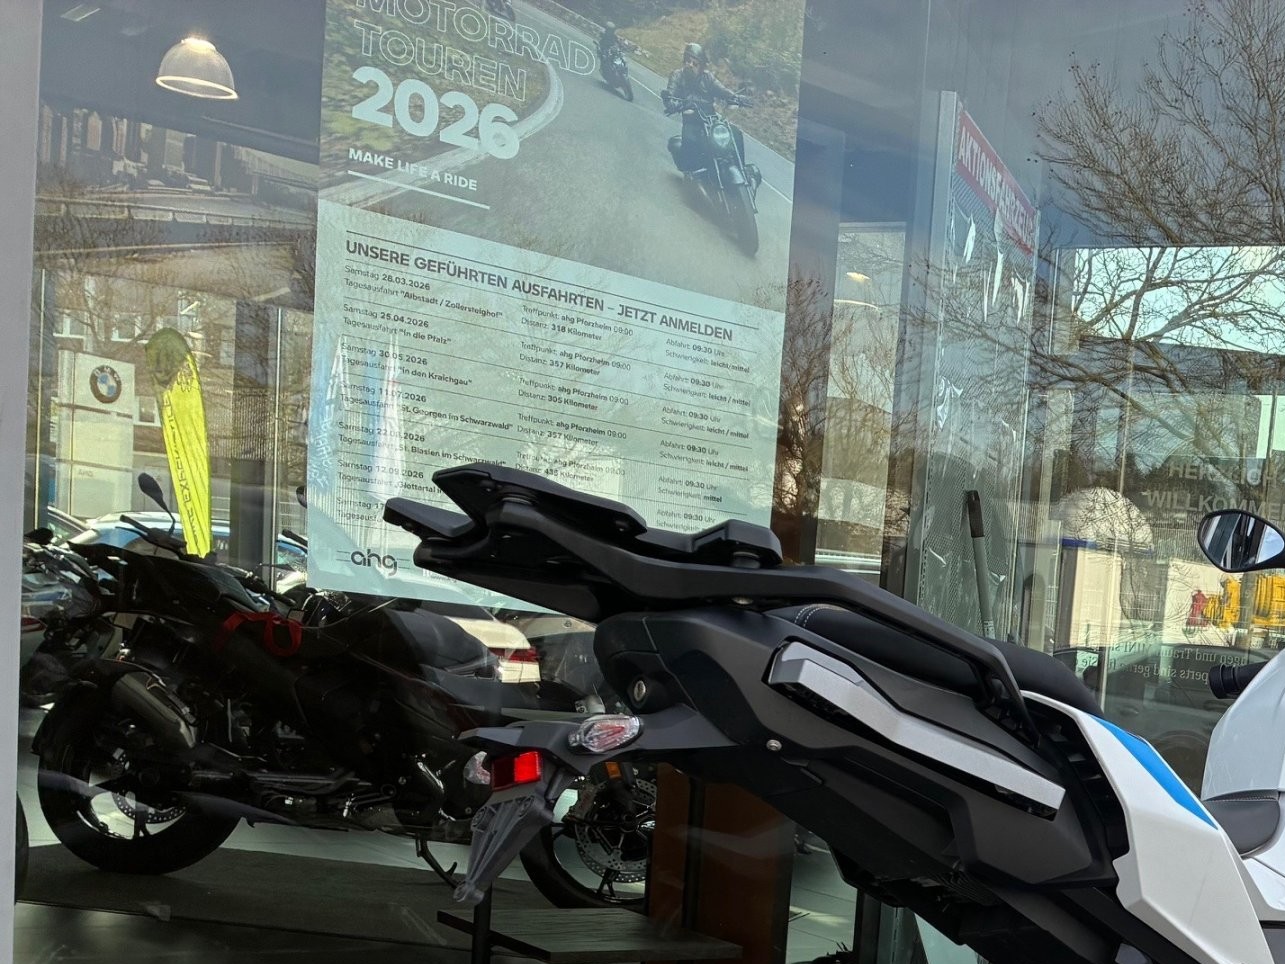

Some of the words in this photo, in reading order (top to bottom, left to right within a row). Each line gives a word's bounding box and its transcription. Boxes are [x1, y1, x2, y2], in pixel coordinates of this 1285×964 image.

[353, 19, 527, 101] TOUREN
[351, 66, 521, 160] 2026
[348, 147, 394, 171] MAKE
[397, 159, 428, 179] LIFE
[430, 168, 442, 182] A
[444, 172, 478, 191] RIDE
[344, 265, 379, 281] Samstag
[382, 273, 430, 291] 28.03.2026
[344, 278, 399, 297] Tagesausfahrt
[346, 240, 410, 267] UNSERE
[414, 256, 508, 289] GEFÜHRTEN
[511, 279, 604, 312] AUSFAHRTEN
[617, 304, 657, 323] JETZT
[659, 314, 733, 341] ANMELDEN
[343, 304, 378, 319] Samstag
[380, 312, 429, 328] 25.04.2026
[522, 305, 559, 320] Treffpunkt:
[561, 315, 575, 325] ahg
[576, 317, 612, 332] Pforzheim
[343, 317, 398, 335] Tagesausfahrt
[413, 331, 426, 341] die
[521, 317, 549, 329] Distanz:
[551, 323, 566, 333] 318
[567, 327, 602, 340] Kilometer
[341, 343, 376, 357] Samstag
[521, 342, 558, 357] Treffpunkt:
[559, 351, 573, 360] ahg
[574, 353, 610, 367] Pforzheim
[611, 360, 631, 372] 09:00
[666, 338, 691, 350] Abfahrt:
[692, 344, 712, 354] 09:30
[713, 349, 725, 357] Uhr
[411, 368, 426, 378] den
[519, 353, 548, 366] Distanz:
[549, 359, 564, 369] 357
[565, 362, 600, 376] Kilometer
[663, 372, 689, 384] Abfahrt:
[690, 378, 711, 388] 09:30
[518, 389, 545, 401] Distanz:
[547, 395, 562, 404] 305
[563, 398, 598, 411] Kilometer
[519, 377, 556, 391] Treffpunkt:
[558, 386, 571, 395] ahg
[572, 387, 608, 401] Pforzheim
[609, 395, 629, 405] 09:00
[708, 393, 727, 402] leicht
[732, 397, 751, 407] mittel
[340, 394, 395, 410] Tagesausfahr
[449, 413, 459, 421] im
[662, 406, 686, 417] Abfahrt:
[688, 411, 708, 421] 09:30
[709, 415, 721, 423] Uhr
[338, 421, 374, 435] Samstag
[518, 413, 555, 426] Treffpunkt:
[556, 421, 569, 430] ahg
[570, 422, 605, 436] Pforzheim
[706, 426, 725, 435] leicht
[730, 431, 749, 439] mittel
[517, 425, 544, 436] Distanz:
[547, 431, 562, 439] 357
[563, 434, 598, 446] Kilometer
[411, 446, 440, 457] Blasien
[442, 450, 452, 459] im
[660, 440, 685, 450] Abfahrt:
[686, 444, 706, 454] 09:30
[338, 459, 373, 472] Samstag
[705, 460, 724, 468] leicht
[730, 464, 749, 472] mittel
[685, 480, 705, 489] 09:30
[703, 494, 722, 503] mittel
[337, 510, 382, 522] Tagesausf
[683, 513, 703, 522] 09:30
[350, 549, 397, 576] ahg
